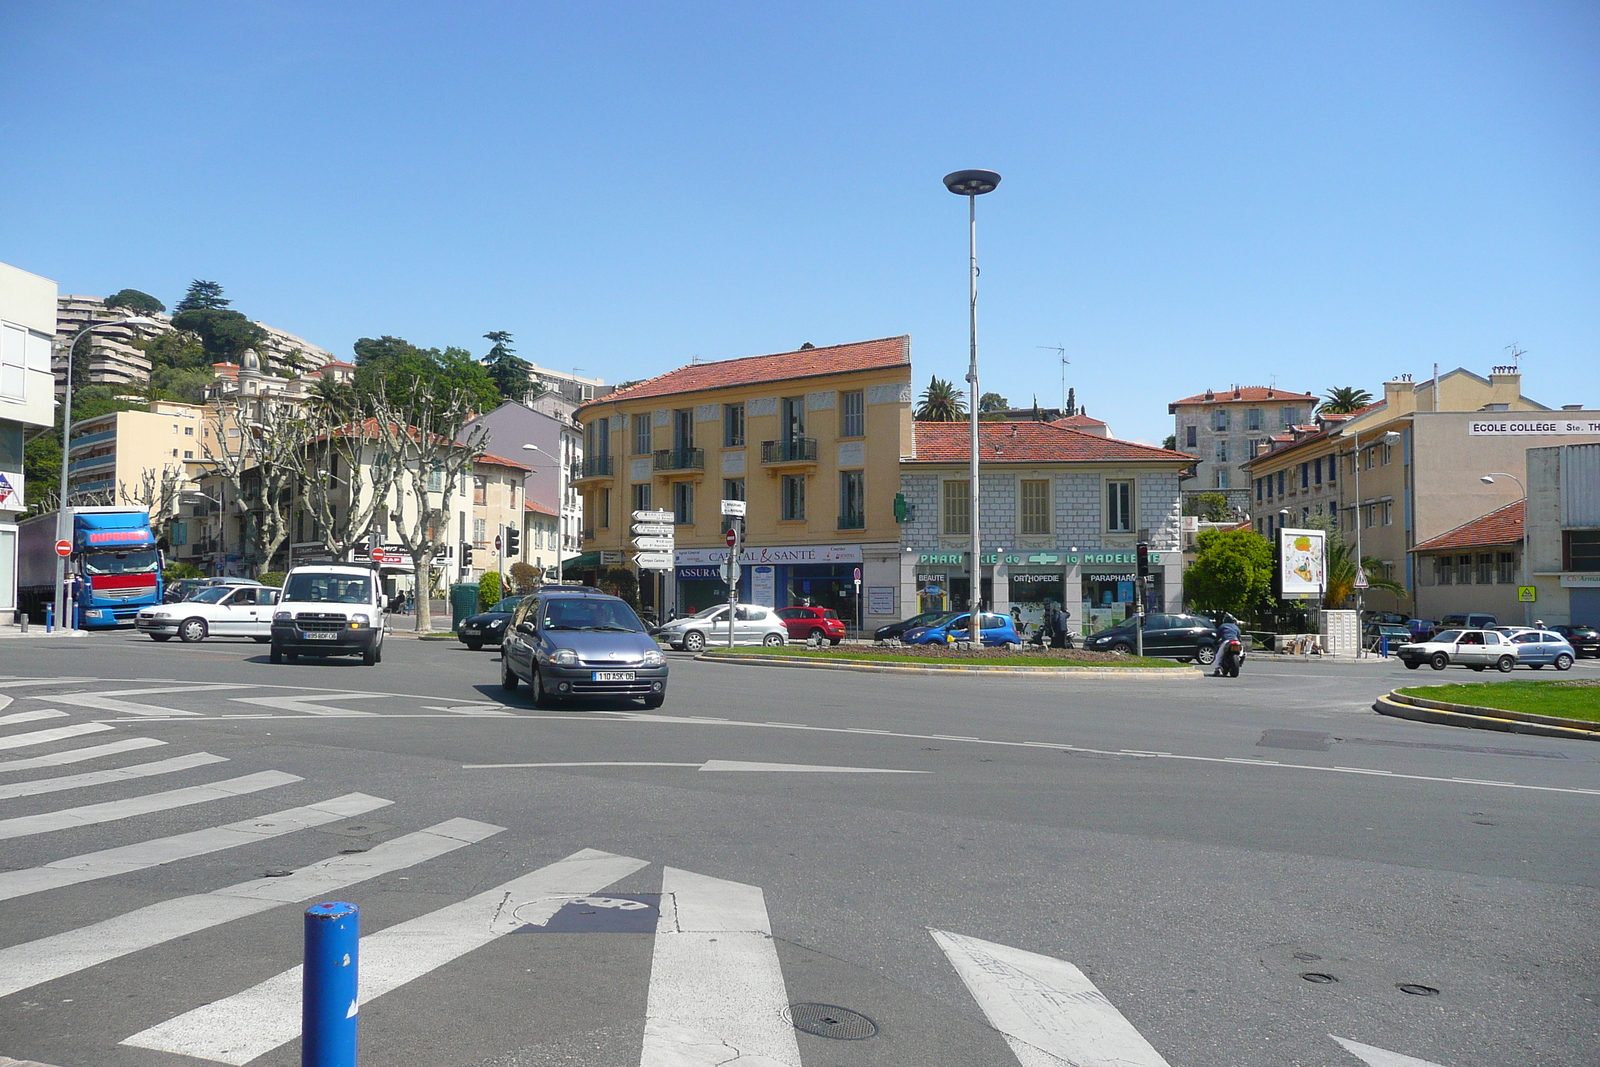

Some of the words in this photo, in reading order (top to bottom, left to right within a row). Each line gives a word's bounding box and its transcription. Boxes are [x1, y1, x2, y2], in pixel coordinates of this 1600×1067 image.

[1510, 422, 1556, 432] COLLÈGE
[708, 551, 759, 561] CAPTAL
[774, 549, 816, 560] SANTÉ
[921, 554, 998, 565] PHARCIE
[1005, 554, 1020, 563] de
[1084, 553, 1160, 564] MADELEE
[679, 568, 721, 577] ASSURAN
[918, 574, 945, 582] BEAUTE
